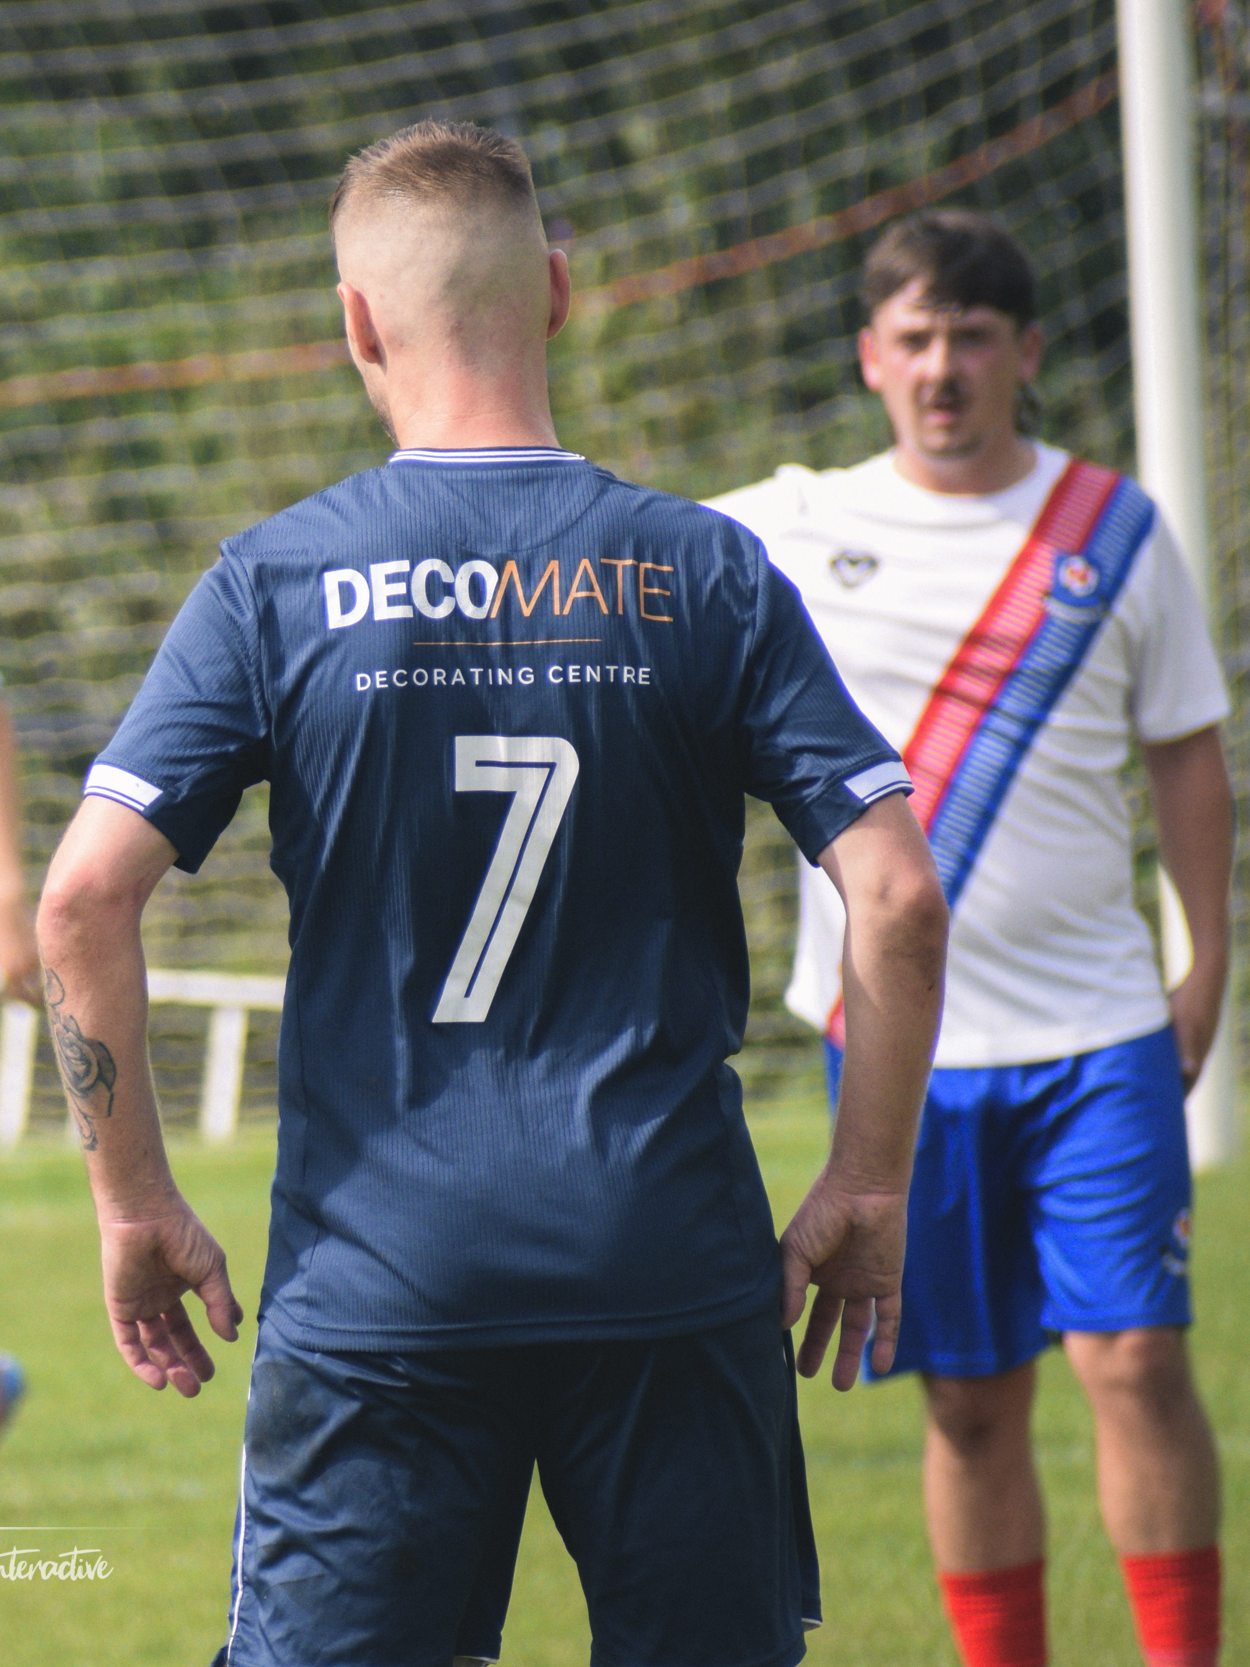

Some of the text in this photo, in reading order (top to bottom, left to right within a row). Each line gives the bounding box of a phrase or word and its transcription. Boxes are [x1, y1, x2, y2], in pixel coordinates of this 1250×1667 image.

[323, 558, 674, 629] DECOMATE
[356, 665, 651, 691] DECORATING CENTRE
[432, 735, 580, 1023] 7
